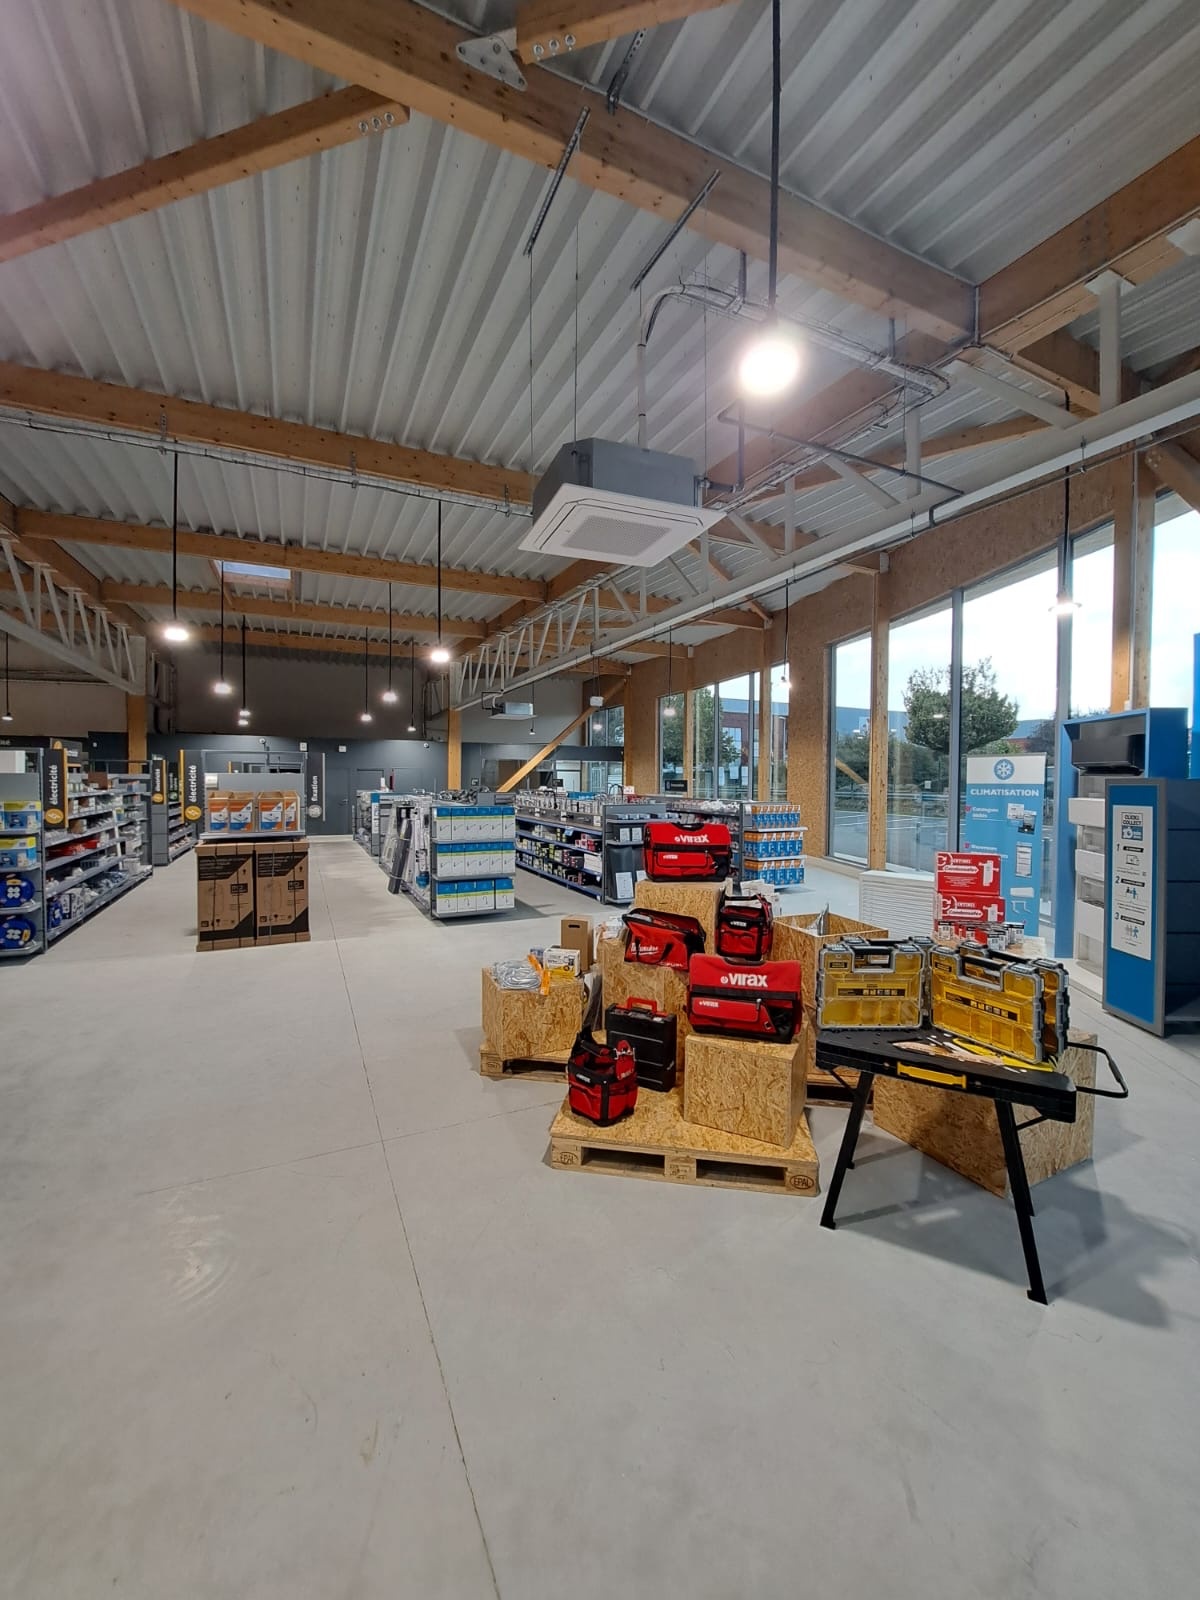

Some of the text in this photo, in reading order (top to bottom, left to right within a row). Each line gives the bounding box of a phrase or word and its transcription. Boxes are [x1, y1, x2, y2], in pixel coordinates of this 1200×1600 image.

[48, 764, 58, 806] électricité
[188, 764, 198, 803] électricité
[970, 787, 1040, 797] CLIMATISATION
[728, 972, 769, 988] virax
[793, 1176, 811, 1188] EPAL
